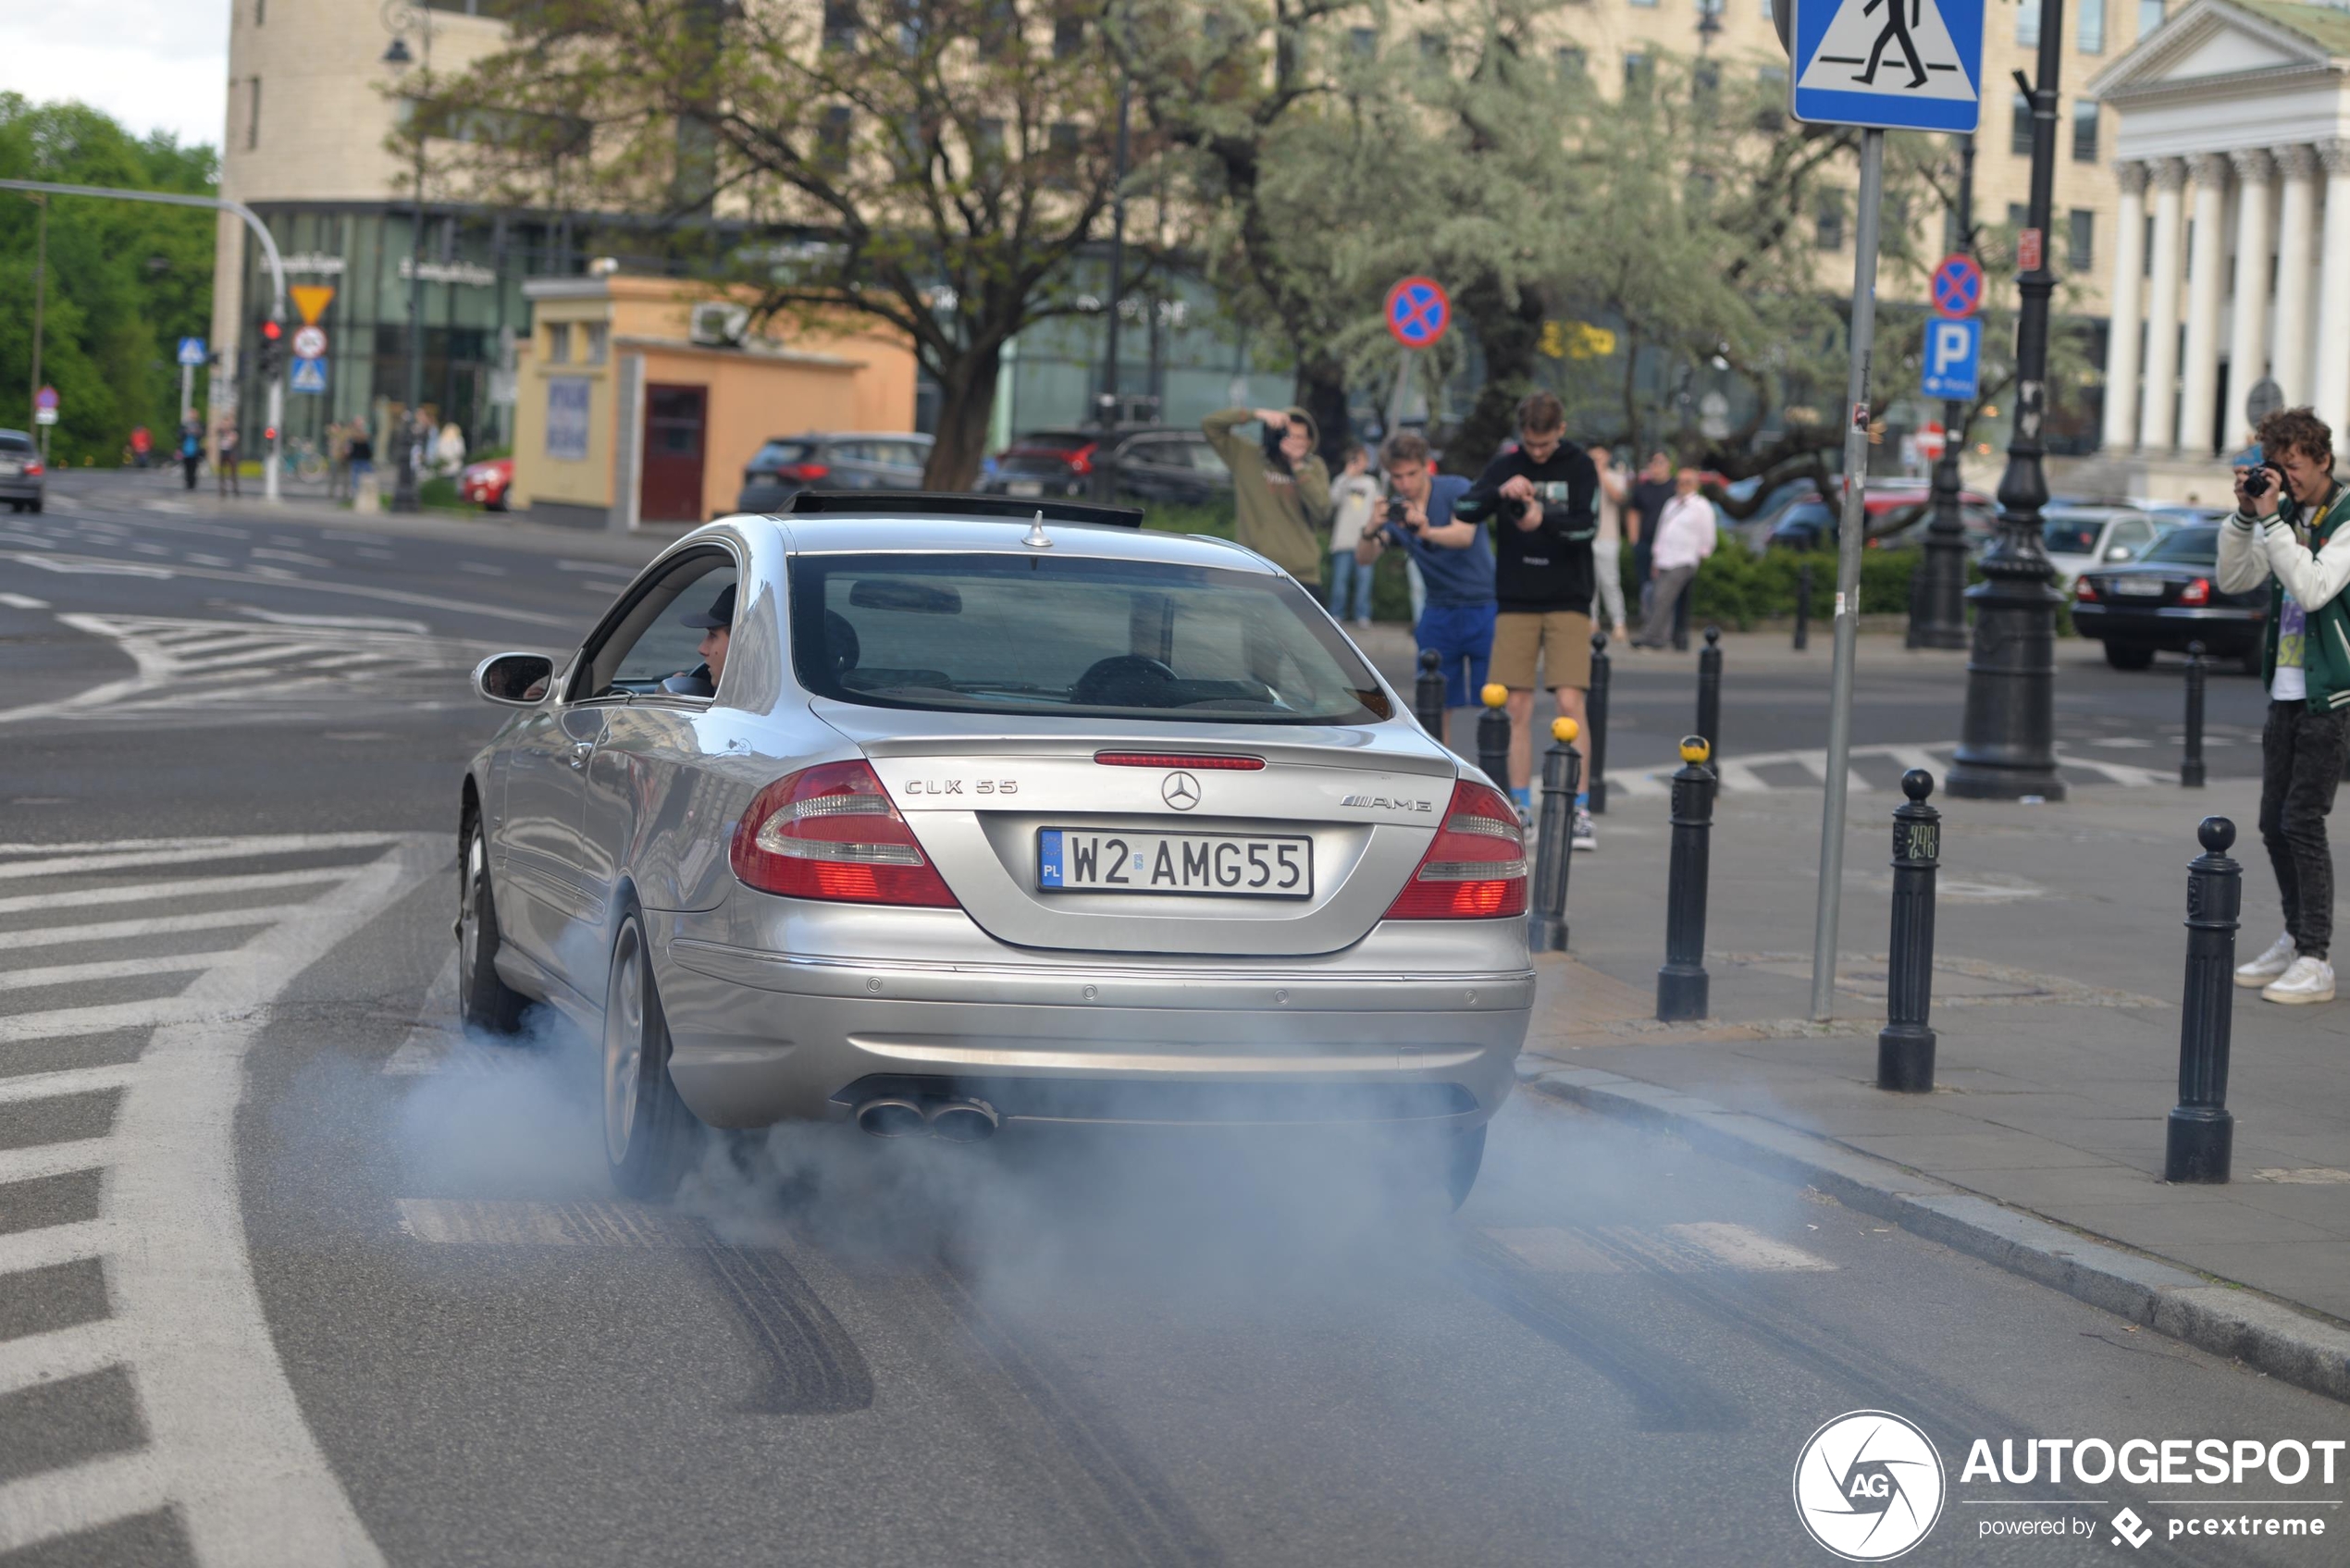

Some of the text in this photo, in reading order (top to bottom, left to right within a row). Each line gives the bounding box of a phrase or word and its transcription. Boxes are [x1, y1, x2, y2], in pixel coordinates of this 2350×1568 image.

[1935, 324, 1971, 375] P
[905, 780, 1018, 795] CLK 55
[1369, 796, 1432, 812] AMG
[1071, 837, 1300, 888] W2 AMG55
[1044, 865, 1059, 878] PL
